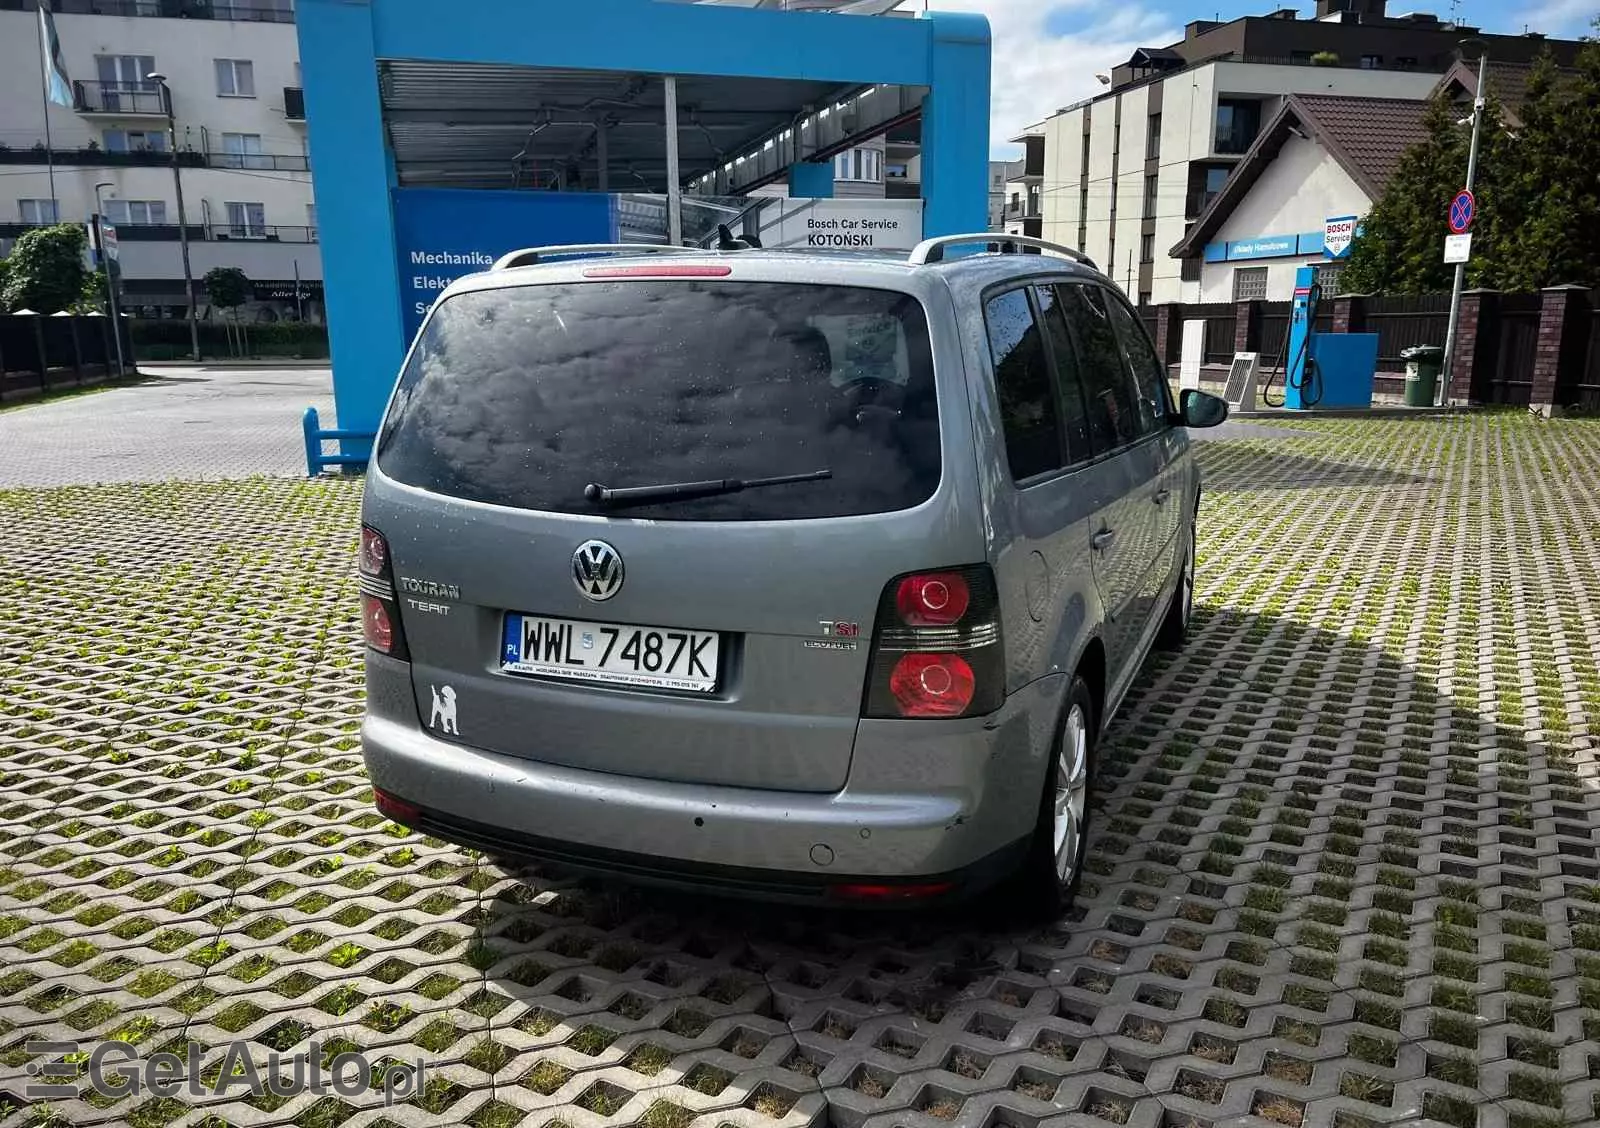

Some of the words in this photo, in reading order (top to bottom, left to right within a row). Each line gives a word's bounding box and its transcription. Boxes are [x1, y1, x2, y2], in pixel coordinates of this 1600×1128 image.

[807, 218, 838, 229] Bosch
[841, 219, 859, 229] Car
[861, 219, 898, 229] Service
[1326, 223, 1351, 233] BOSCH
[808, 231, 873, 246] KOTOŃSKI
[1326, 234, 1351, 243] Service
[410, 251, 493, 265] Mechanika
[400, 576, 460, 599] TOURAN
[819, 620, 858, 637] TSI
[506, 643, 518, 656] PL
[524, 620, 584, 665] WWL
[598, 627, 713, 677] 7487K
